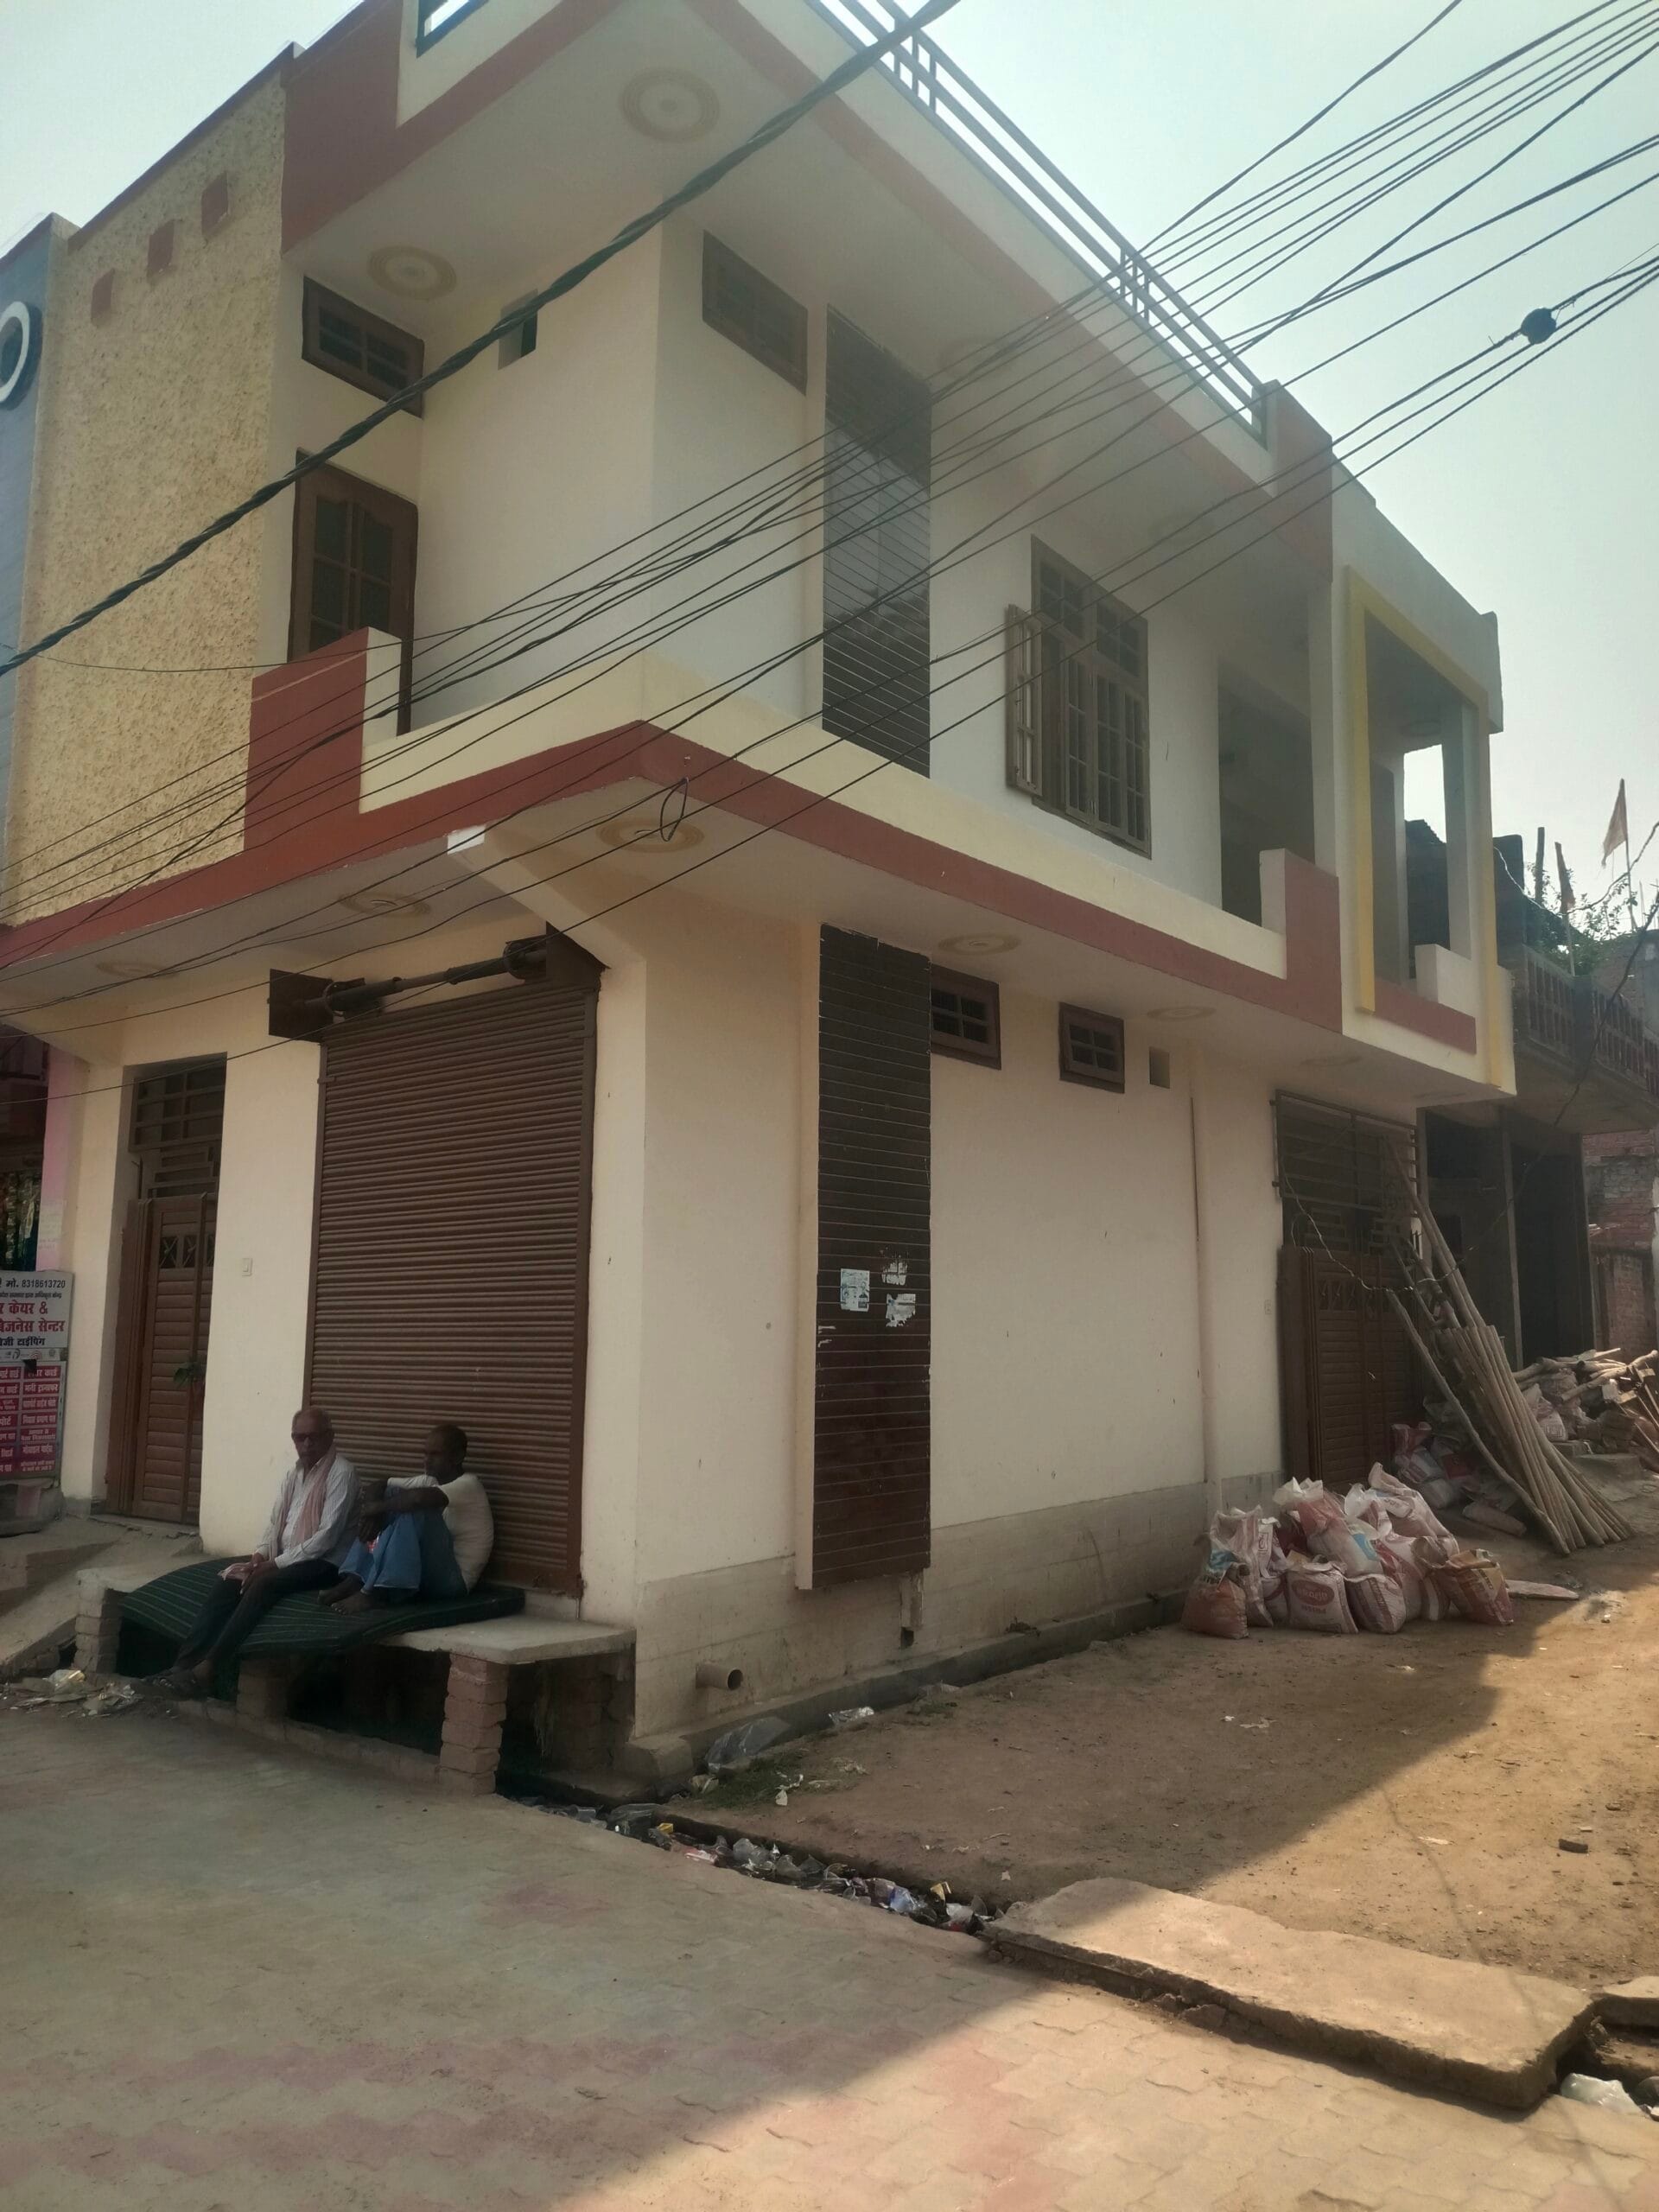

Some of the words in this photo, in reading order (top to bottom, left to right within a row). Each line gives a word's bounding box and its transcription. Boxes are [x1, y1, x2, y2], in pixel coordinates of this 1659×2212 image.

[6, 1278, 19, 1287] मो.
[22, 1280, 66, 1288] 8318613720
[9, 1300, 35, 1314] केयर
[39, 1301, 48, 1314] &
[38, 1318, 66, 1332] सेन्टर
